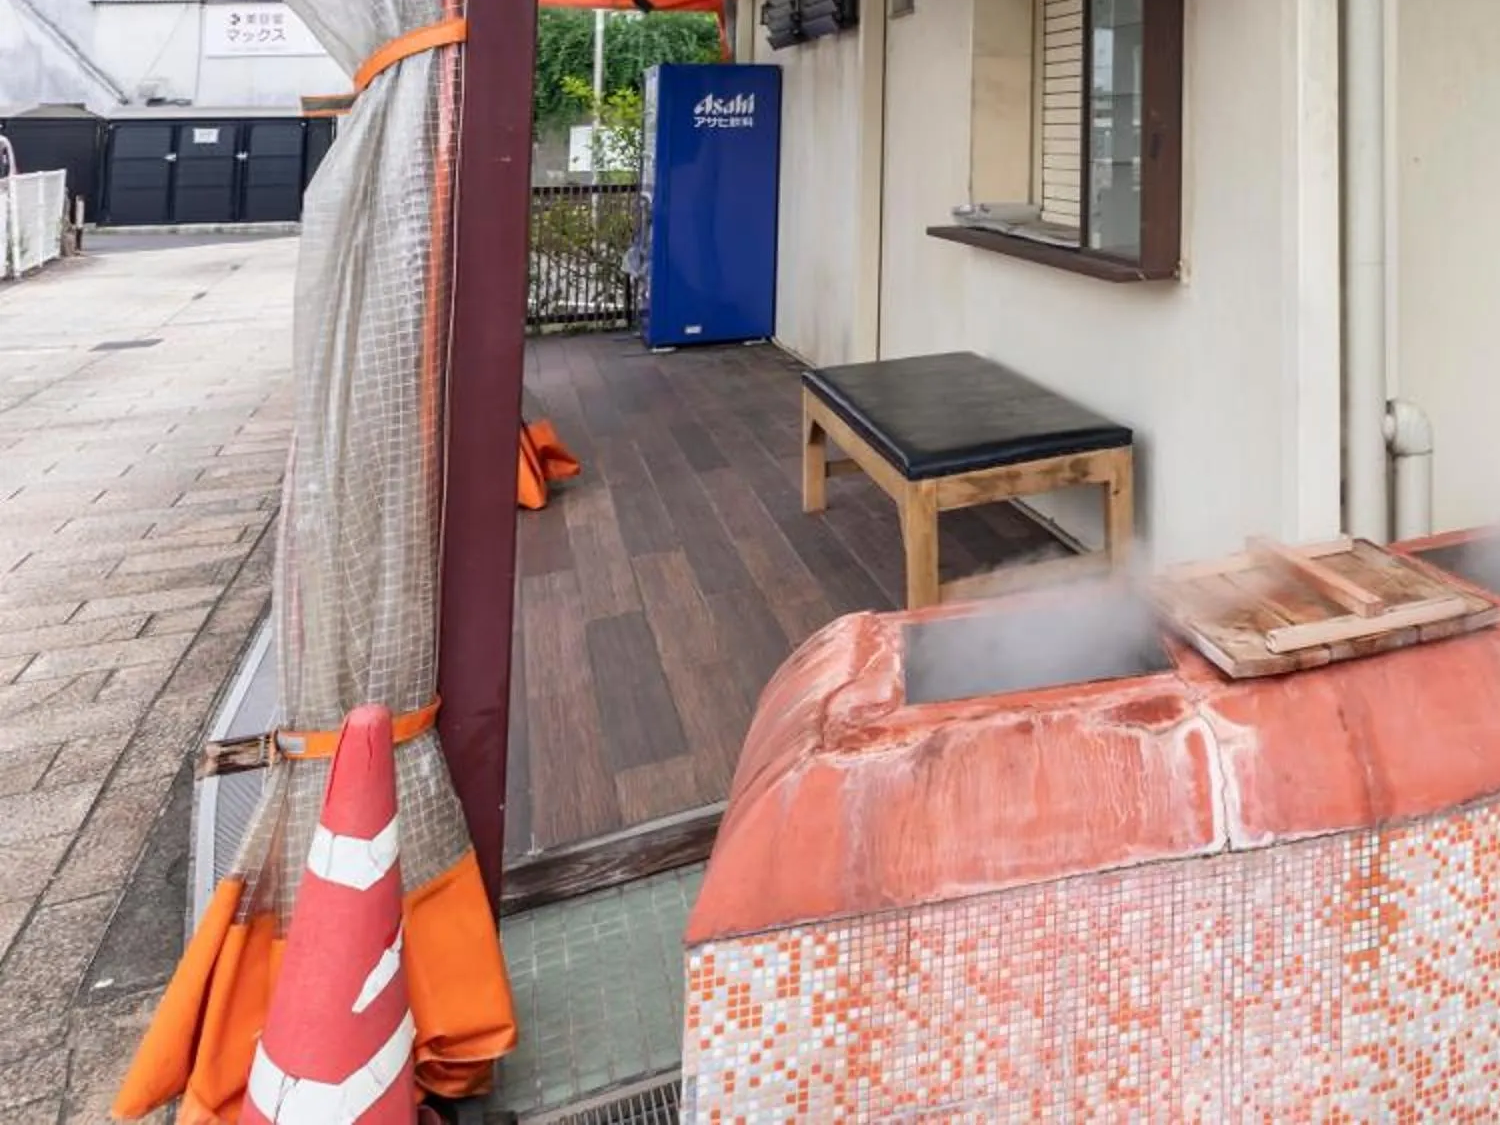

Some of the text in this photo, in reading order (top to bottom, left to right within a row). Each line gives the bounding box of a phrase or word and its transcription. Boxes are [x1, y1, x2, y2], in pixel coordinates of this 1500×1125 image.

[228, 28, 286, 42] マックス
[693, 92, 755, 115] Asahi
